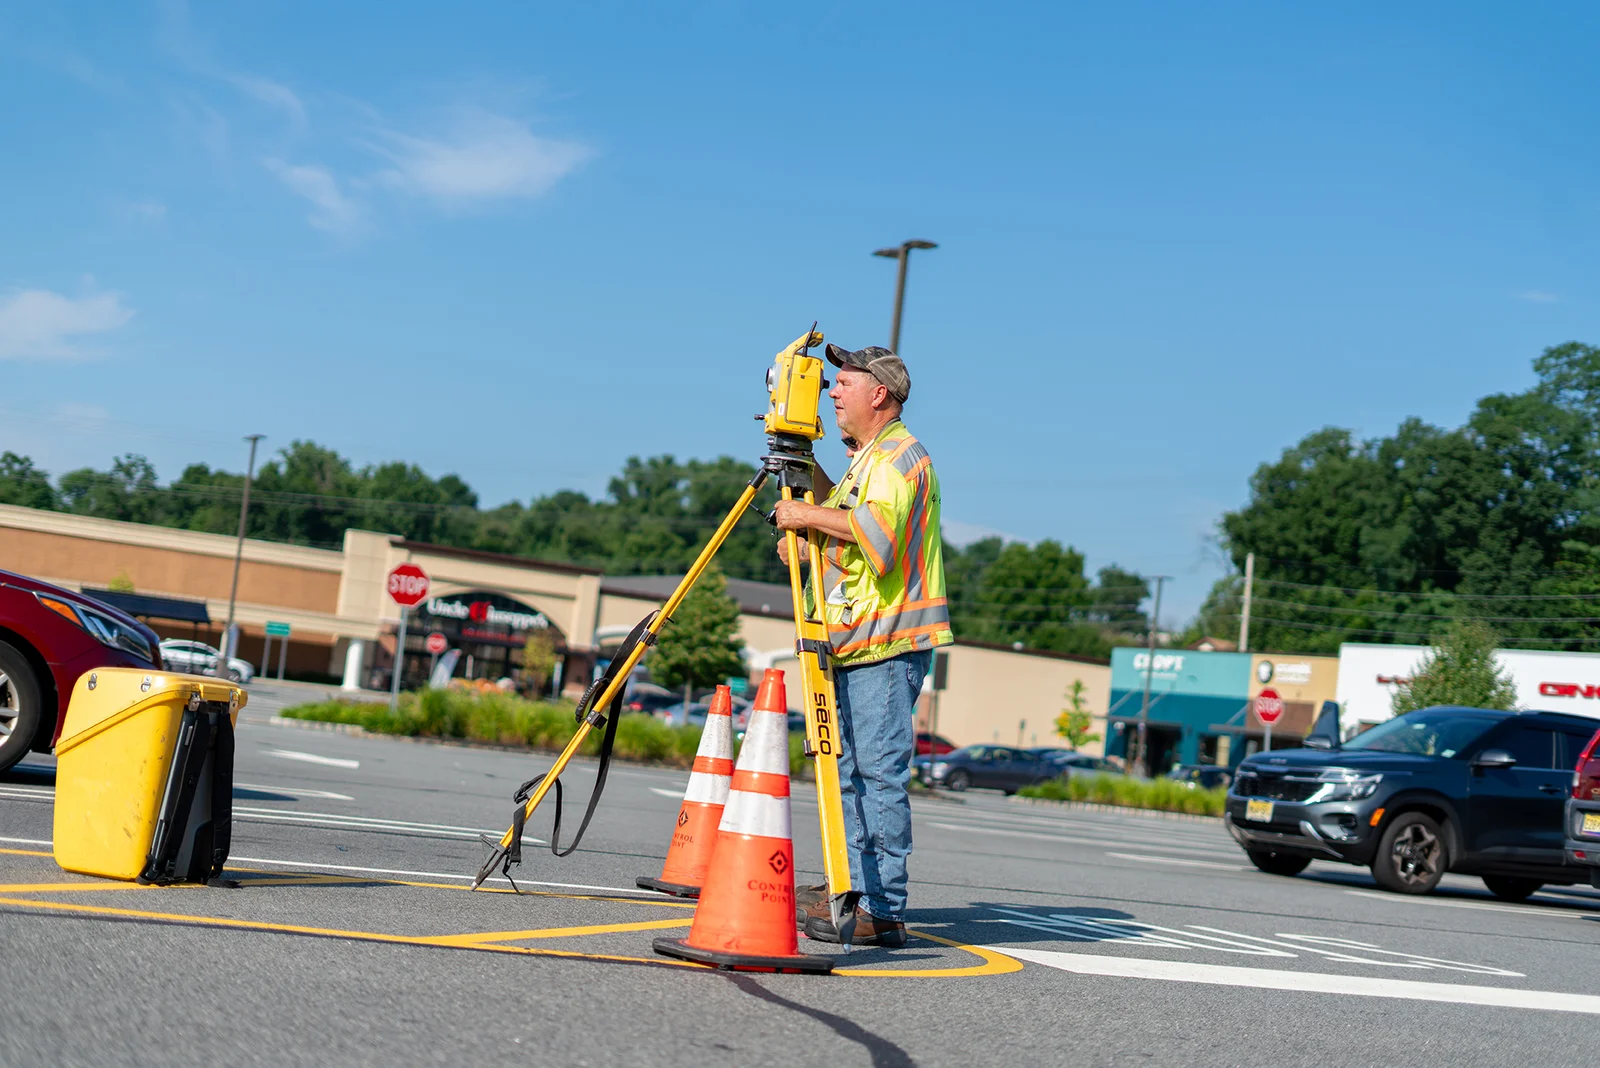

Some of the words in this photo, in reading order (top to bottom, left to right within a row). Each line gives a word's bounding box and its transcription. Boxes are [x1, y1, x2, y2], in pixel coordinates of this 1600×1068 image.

[389, 574, 428, 596] STOP
[427, 598, 470, 619] Uncle
[1254, 697, 1283, 714] STOP
